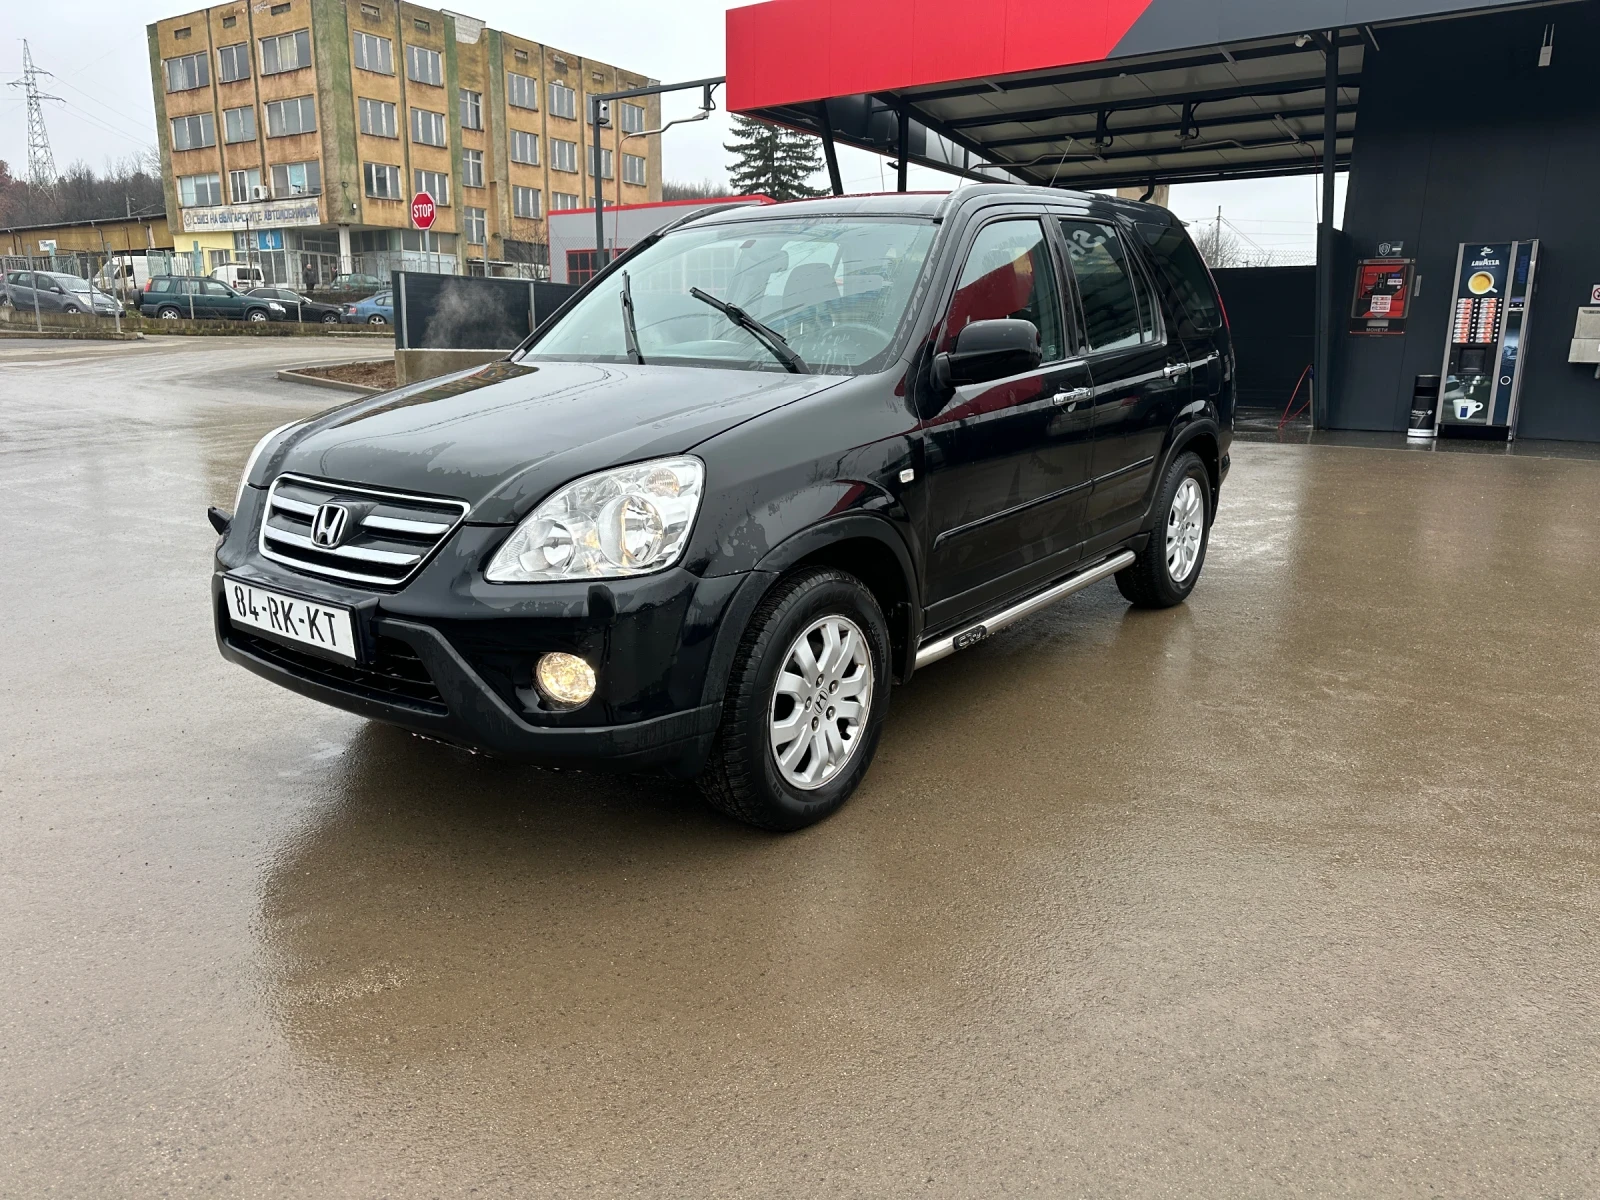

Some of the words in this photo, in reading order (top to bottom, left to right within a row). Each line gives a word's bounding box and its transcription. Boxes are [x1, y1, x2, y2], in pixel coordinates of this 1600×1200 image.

[193, 214, 208, 225] СЪЮЗ
[210, 213, 218, 224] НА
[219, 210, 262, 224] БЪЛГАРСКИТЕ
[413, 203, 433, 218] STOP
[1471, 258, 1500, 267] LAVAZZA
[234, 585, 336, 647] 84-RK-KT
